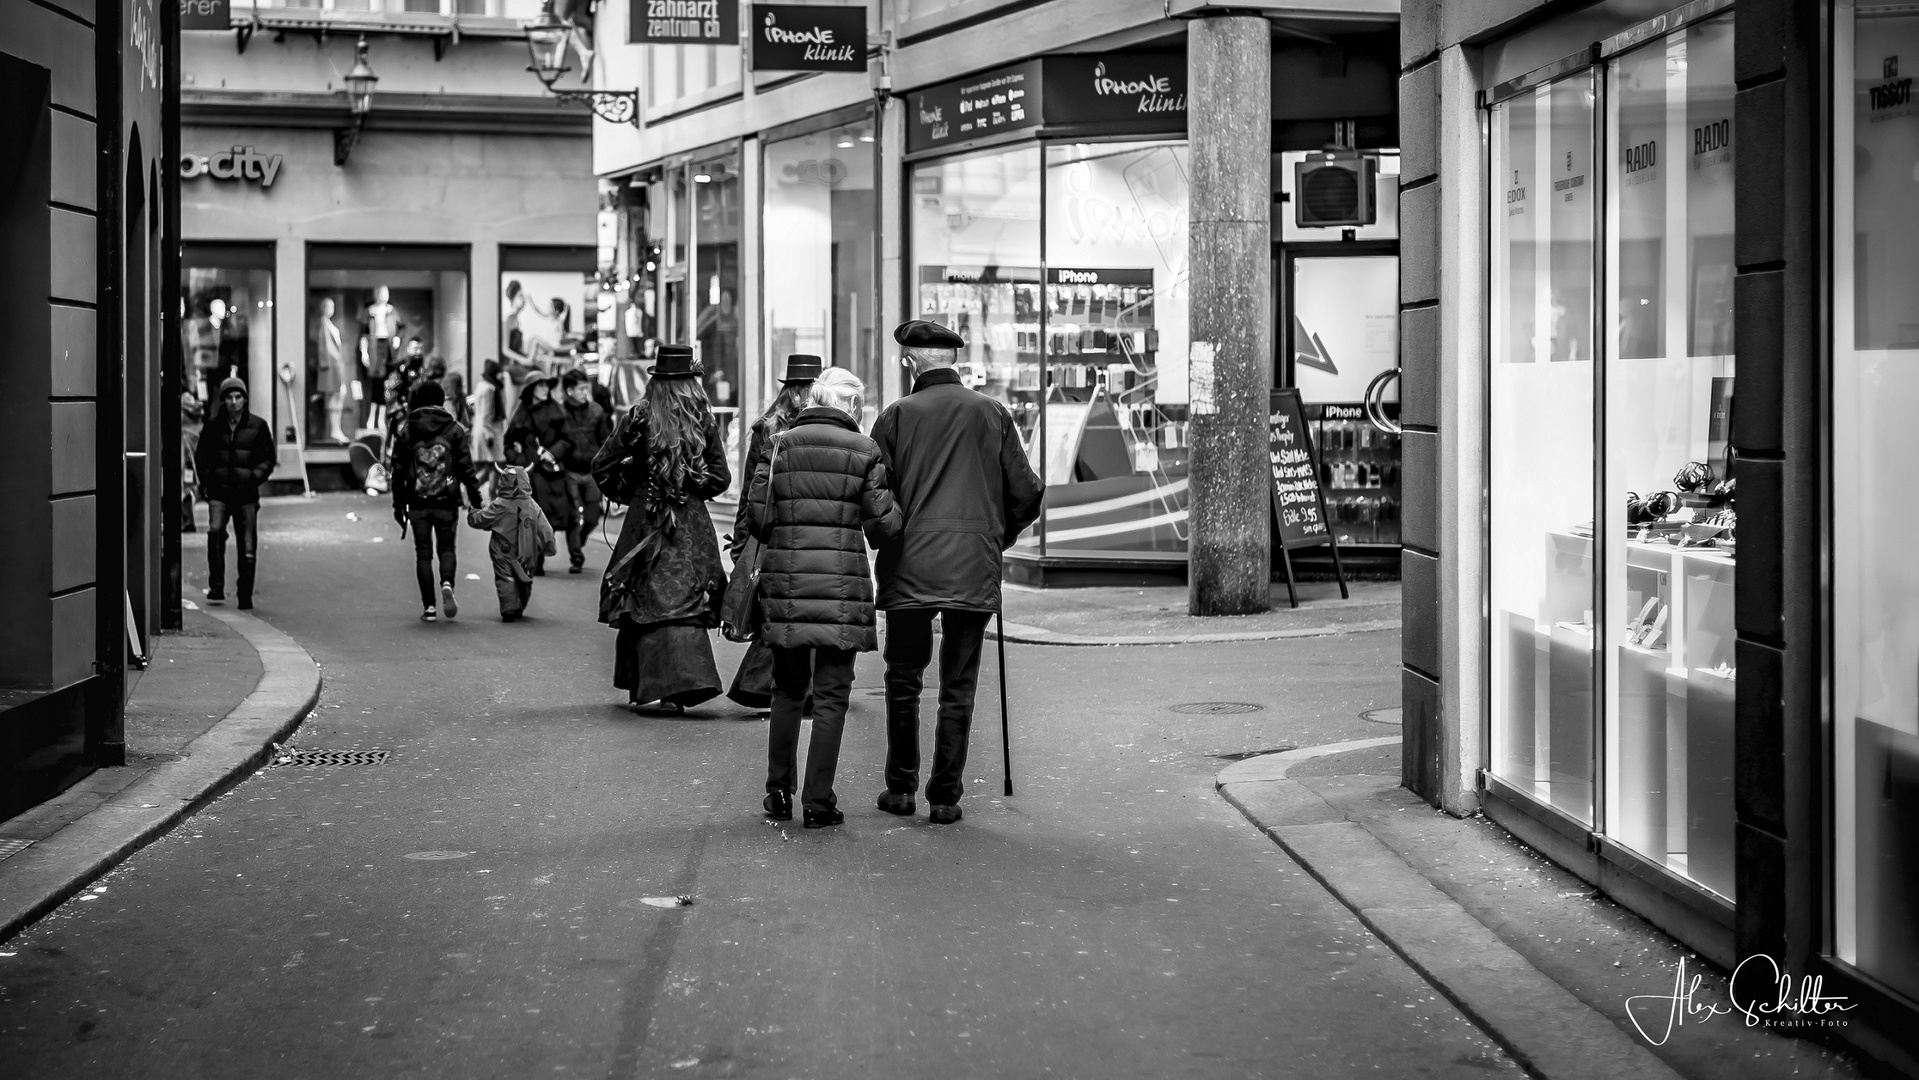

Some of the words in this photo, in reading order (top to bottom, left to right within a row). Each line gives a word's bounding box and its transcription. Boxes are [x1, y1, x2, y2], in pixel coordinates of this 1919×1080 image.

[647, 0, 719, 18] zahnarzt
[804, 44, 855, 61] klinik
[1137, 93, 1188, 113] klini
[1870, 78, 1912, 111] TISSOT
[1694, 119, 1730, 155] RADO
[1626, 140, 1656, 174] RADO
[1507, 187, 1526, 204] EDOX
[1059, 269, 1098, 284] iPhone
[1326, 405, 1363, 419] iPhone
